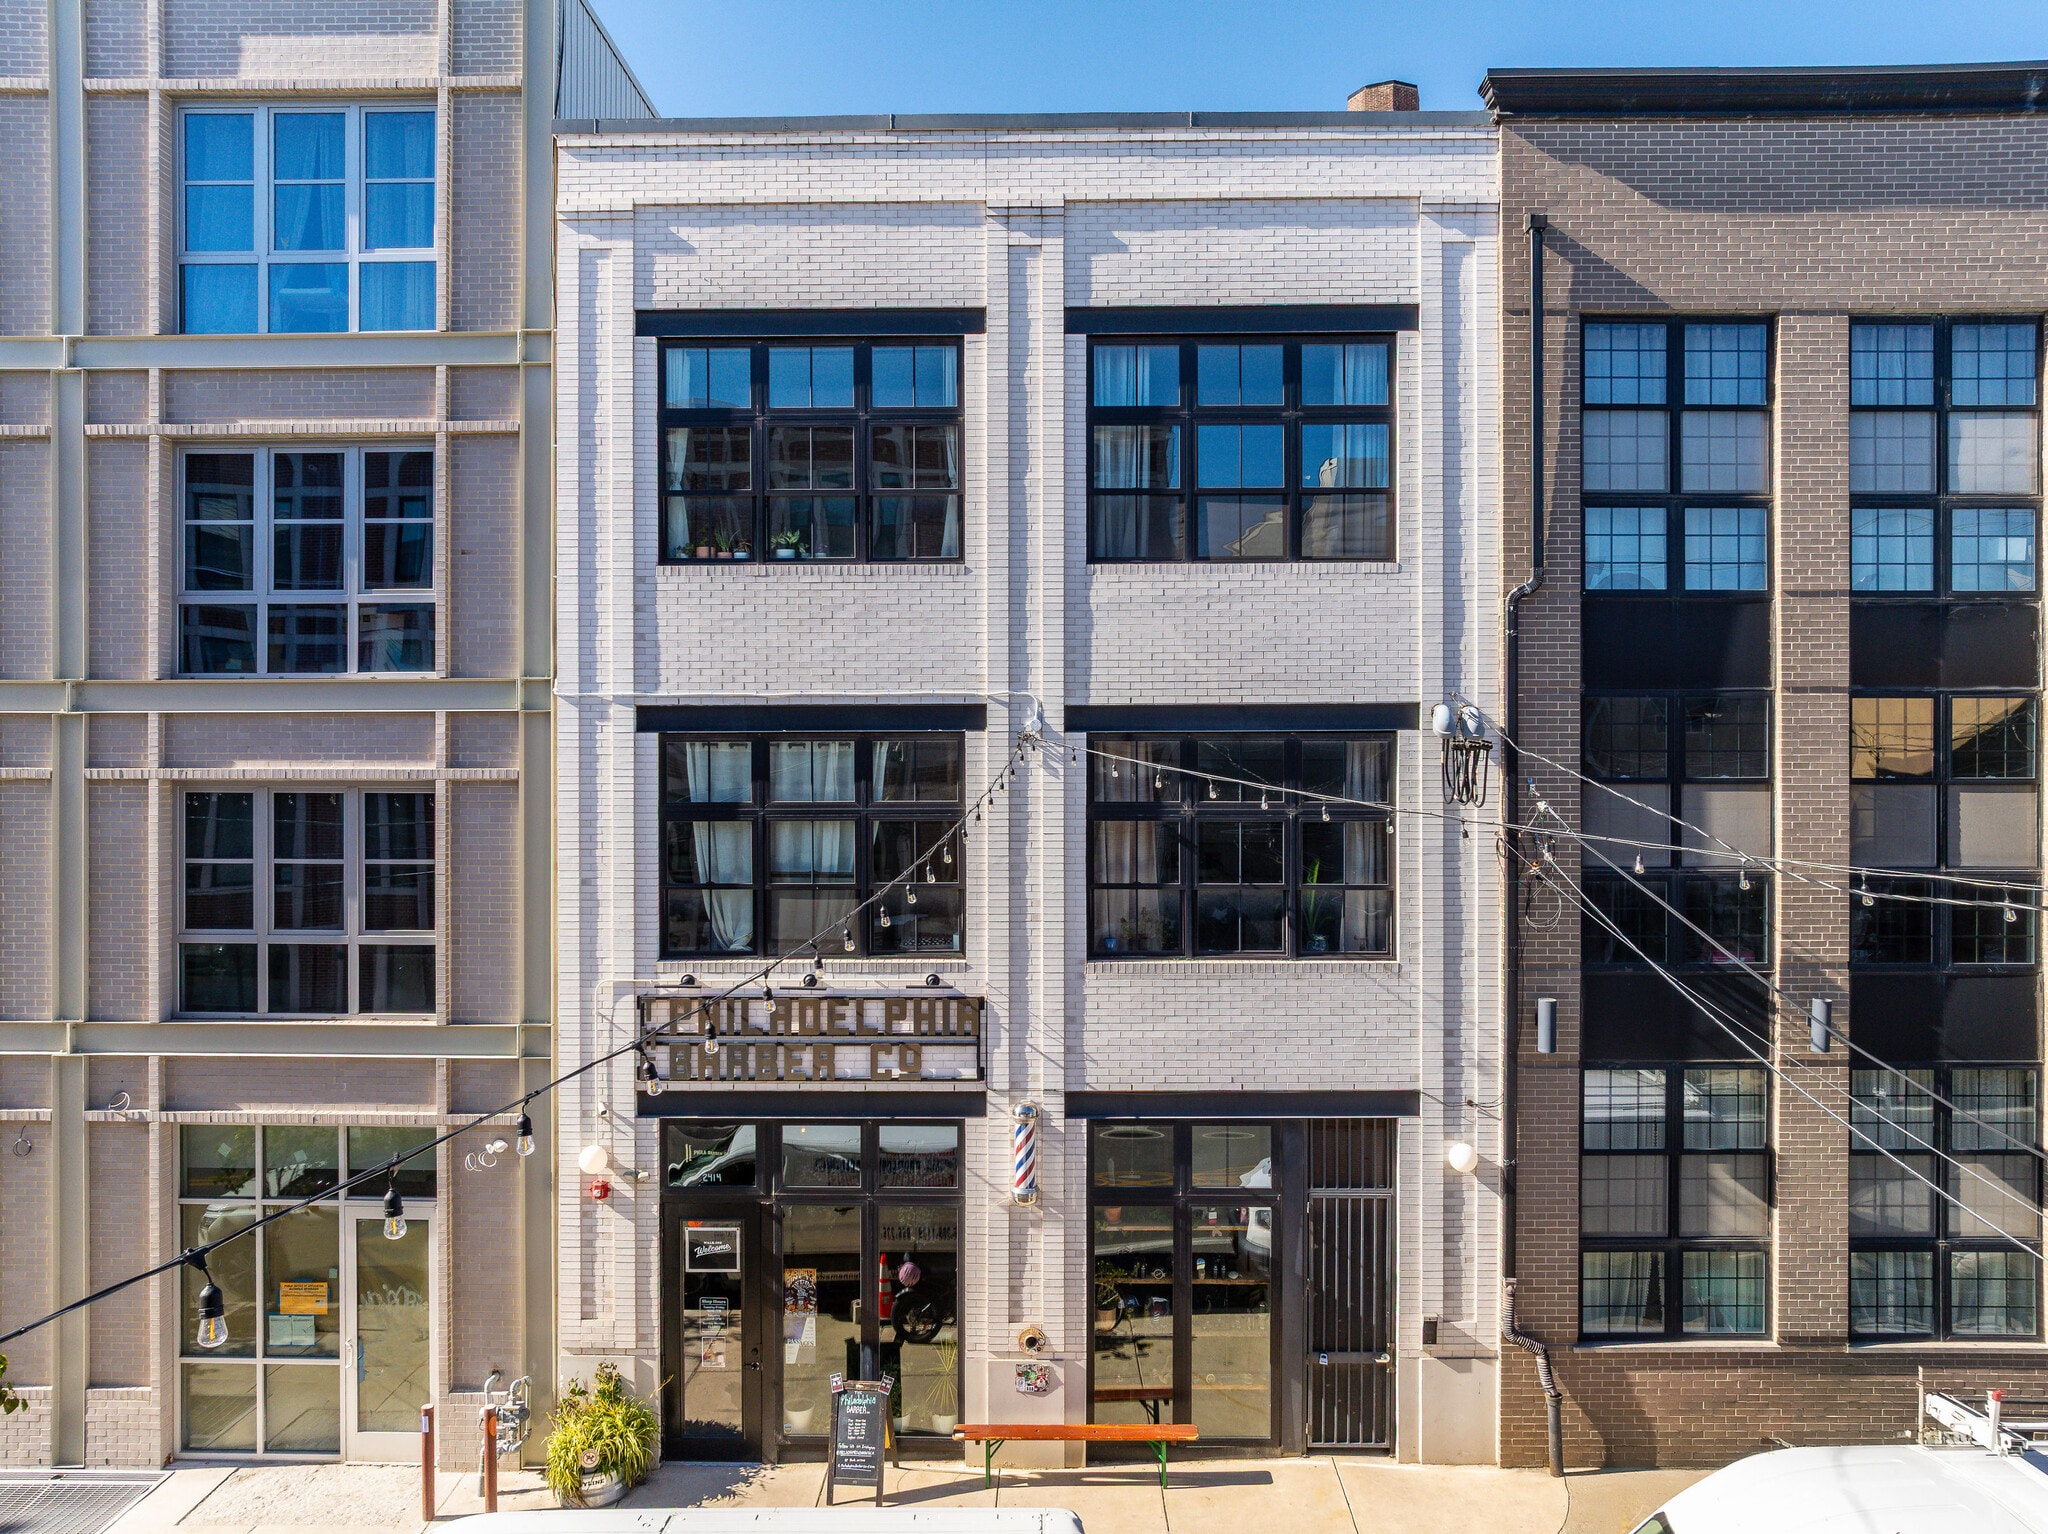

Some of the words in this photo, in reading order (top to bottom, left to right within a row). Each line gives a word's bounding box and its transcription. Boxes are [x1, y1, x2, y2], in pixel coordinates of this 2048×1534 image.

[669, 998, 979, 1035] PHILADELPHIA
[669, 1043, 835, 1081] BARBER
[702, 1173, 722, 1182] 2414
[694, 1243, 732, 1258] Welcome
[846, 1405, 867, 1414] BARBER
